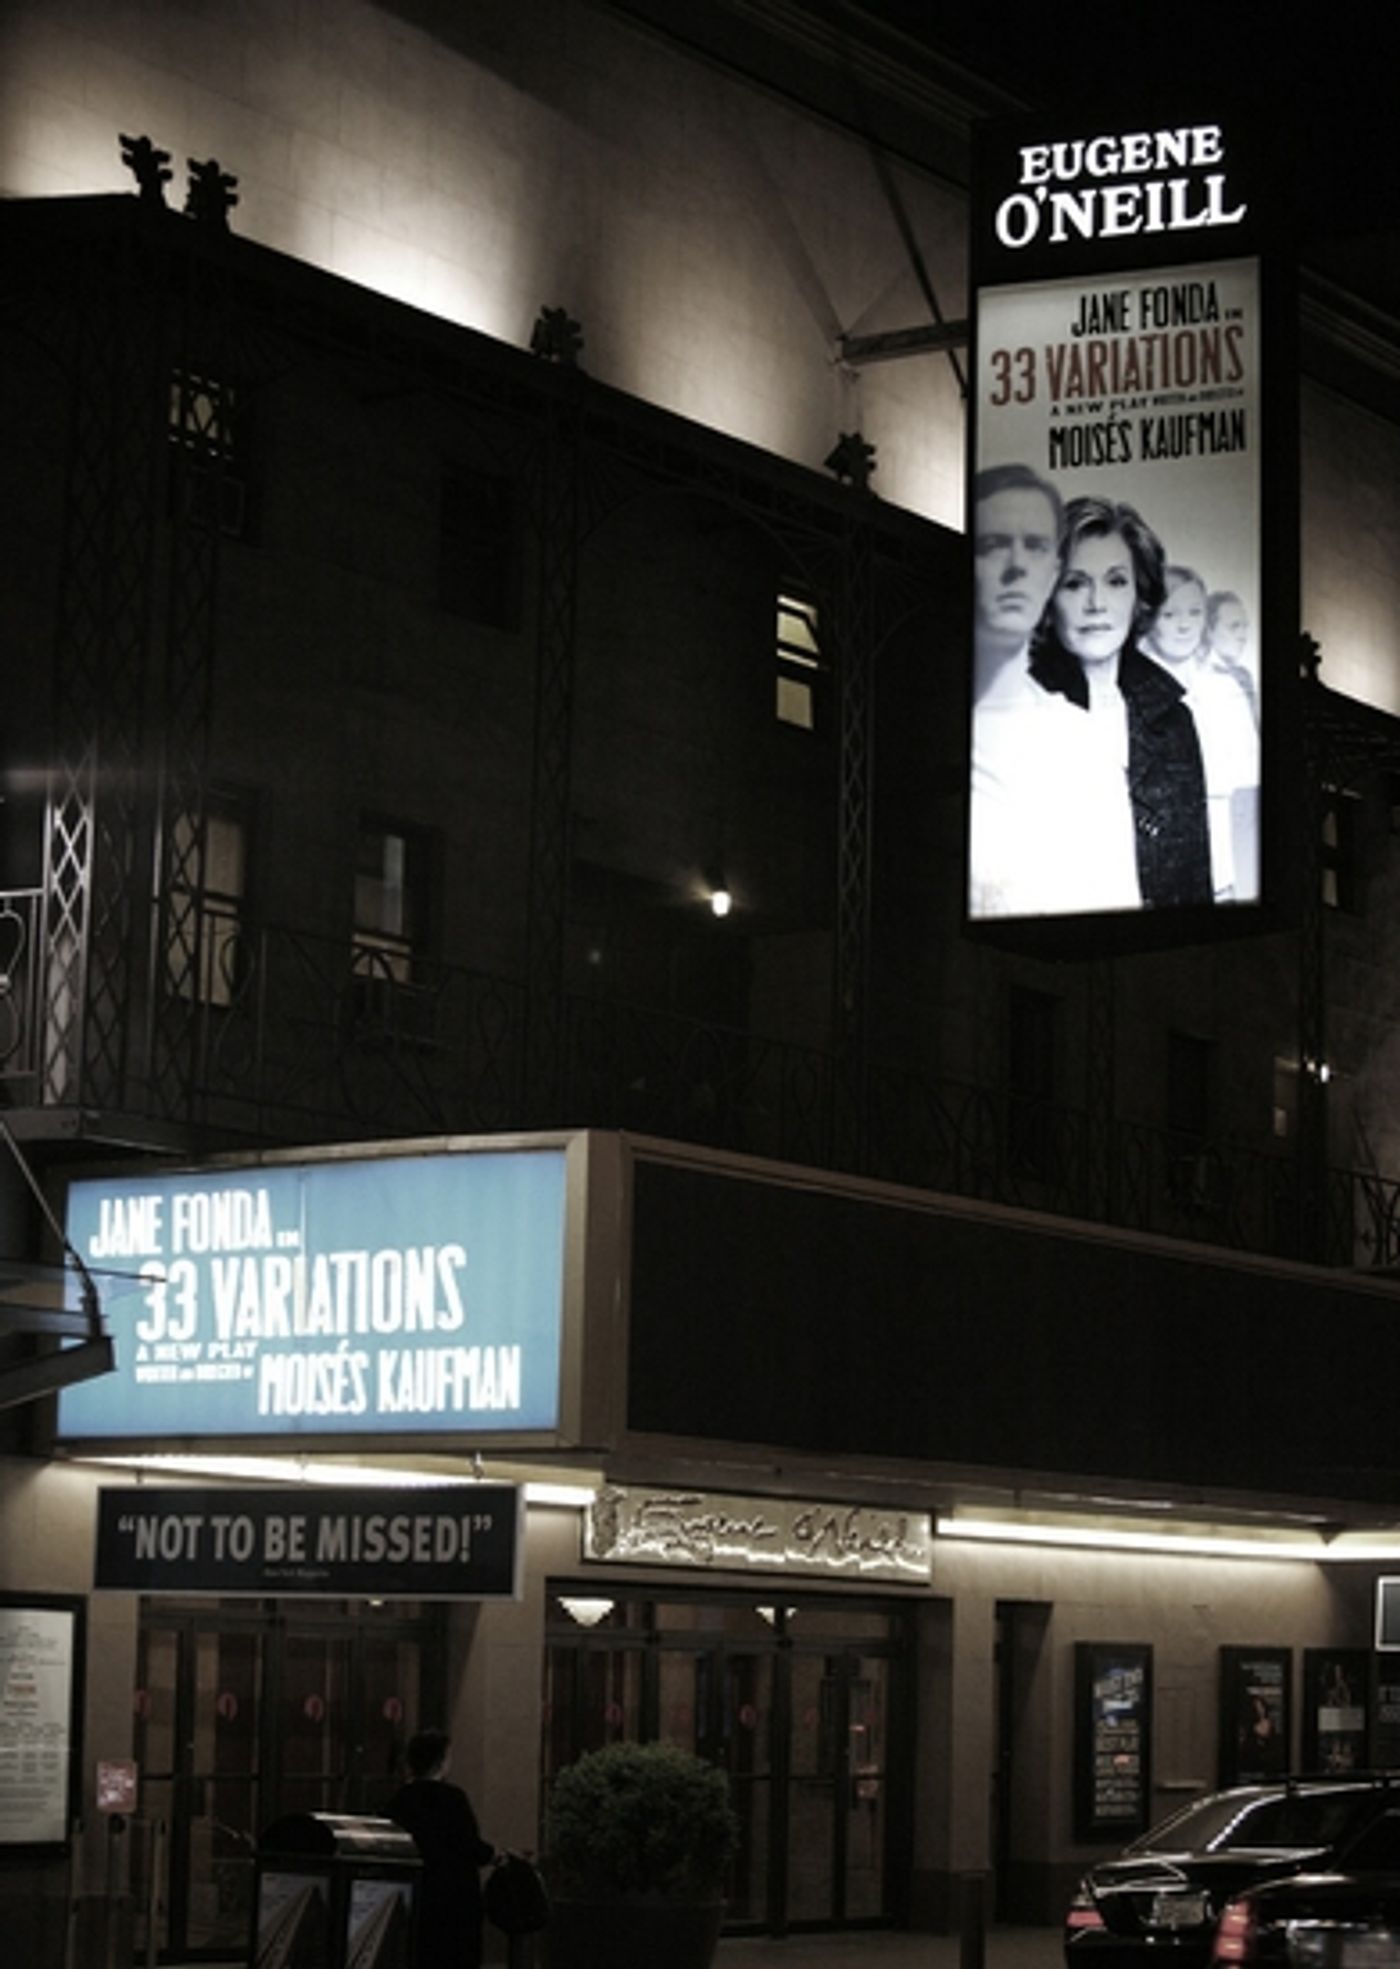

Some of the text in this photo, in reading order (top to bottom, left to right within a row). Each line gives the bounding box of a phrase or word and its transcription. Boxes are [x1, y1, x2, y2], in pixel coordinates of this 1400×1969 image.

[1019, 125, 1224, 184] EUGENE
[995, 175, 1247, 248] O'NEILL
[1071, 290, 1131, 337] JANE
[1140, 281, 1218, 330] FONDA
[990, 325, 1244, 406] 33 VARIATIONS
[1066, 402, 1103, 415] NEW
[1109, 397, 1149, 412] PLAY
[1049, 408, 1246, 470] MOISÉS KAUFMAN
[89, 1197, 162, 1257] JANE
[172, 1189, 271, 1254] FONDA
[136, 1245, 466, 1342] 33 VARIATIONS
[136, 1341, 258, 1361] A NEW PLAY
[258, 1339, 521, 1415] MOISÉS KAUFMAN
[211, 1516, 255, 1561] TO
[265, 1516, 306, 1561] BE
